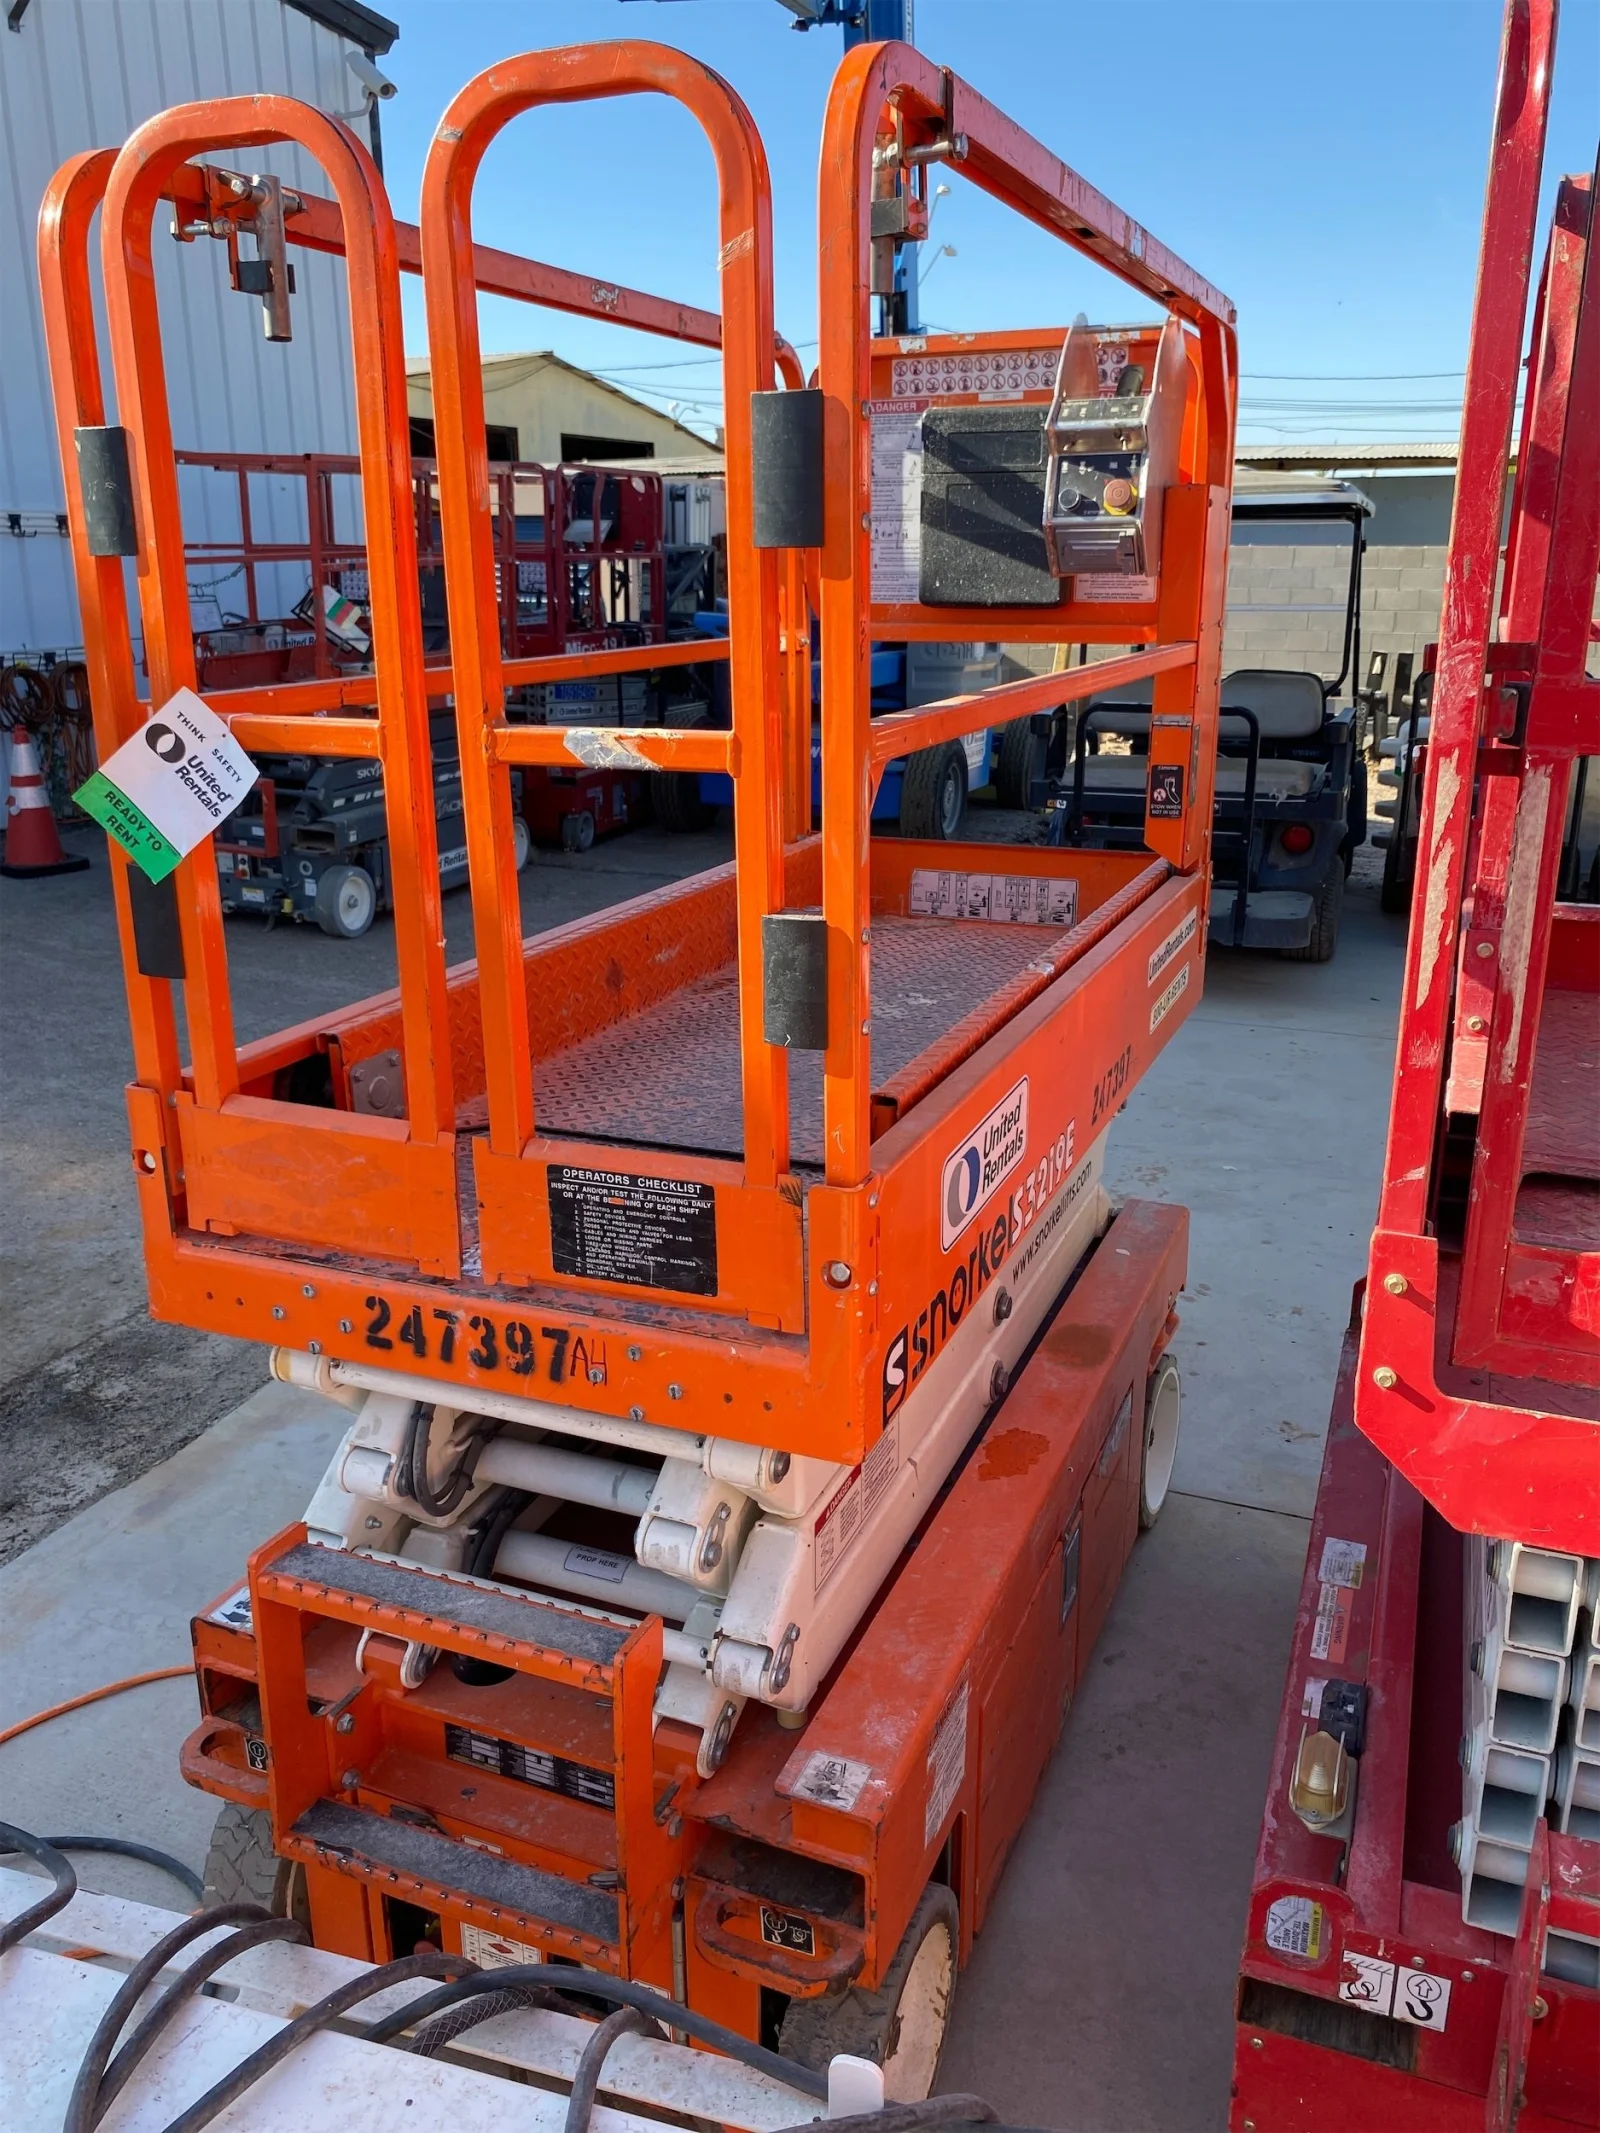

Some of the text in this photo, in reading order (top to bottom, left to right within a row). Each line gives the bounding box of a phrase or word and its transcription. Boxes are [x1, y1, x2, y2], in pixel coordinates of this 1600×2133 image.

[876, 402, 917, 412] DANGER
[176, 711, 242, 783] THINK SAFETY
[175, 765, 222, 818] Rentals
[187, 754, 232, 803] United
[104, 791, 162, 851] READY TO
[106, 814, 141, 848] RENT
[1149, 918, 1196, 981] UnitedRentals.com
[1091, 1044, 1132, 1126] 247397
[982, 1093, 1023, 1159] United
[982, 1128, 1024, 1195] Rentals
[551, 1182, 712, 1208] INSPECT AND/OR TEST THE FOLLOWING DAILY
[563, 1168, 702, 1194] OPERATORS CHECKLIST
[586, 1194, 600, 1202] THE
[657, 1204, 676, 1212] EACH
[679, 1207, 699, 1215] SHIFT
[626, 1210, 656, 1218] EMERGENCY
[1011, 1158, 1093, 1286] www.snorkellifts.com
[612, 1221, 642, 1229] PROTECTIVE
[912, 1193, 1015, 1385] snorkel
[364, 1295, 570, 1383] 247397
[829, 1476, 852, 1515] DANGER
[576, 1554, 618, 1568] PROP HERE
[1282, 1928, 1291, 1949] ANGLE
[1291, 1921, 1301, 1952] TIE-DOWN
[1300, 1922, 1310, 1953] MAXIMUM
[1311, 1918, 1320, 1946] WARNING
